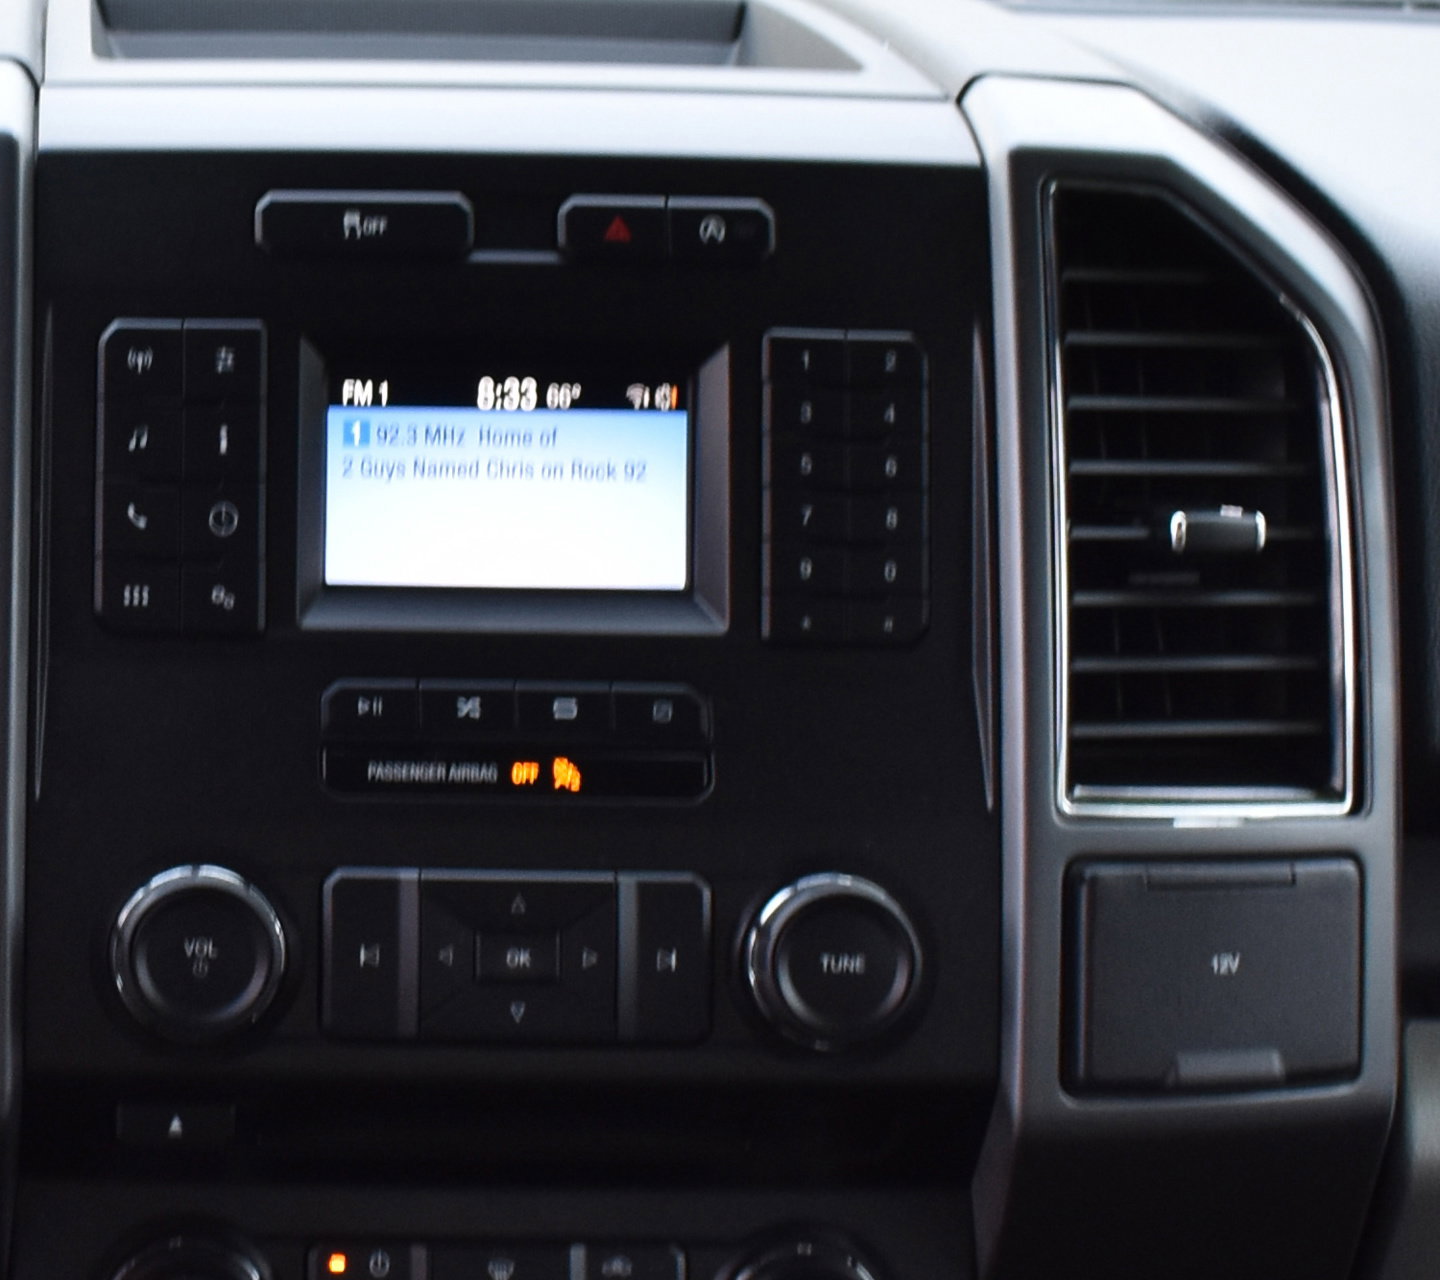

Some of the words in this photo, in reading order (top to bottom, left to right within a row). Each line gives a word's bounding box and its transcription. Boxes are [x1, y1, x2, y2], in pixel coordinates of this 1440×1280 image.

[341, 377, 374, 407] FM
[378, 378, 389, 407] 1
[476, 375, 538, 411] 8:33
[375, 424, 418, 448] 92.3
[423, 424, 466, 447] MHz
[478, 425, 534, 447] Home
[538, 425, 559, 448] of
[359, 458, 407, 482] Guys
[412, 458, 481, 480] Named
[485, 459, 535, 480] Chris
[540, 463, 565, 481] on
[570, 459, 617, 482] Rock
[622, 460, 648, 483] 92
[366, 761, 447, 783] PASSENGER
[448, 762, 499, 784] AIRBAG
[511, 761, 540, 786] OFF
[183, 937, 217, 958] VOL
[505, 948, 531, 969] OK
[821, 953, 866, 975] TUNE
